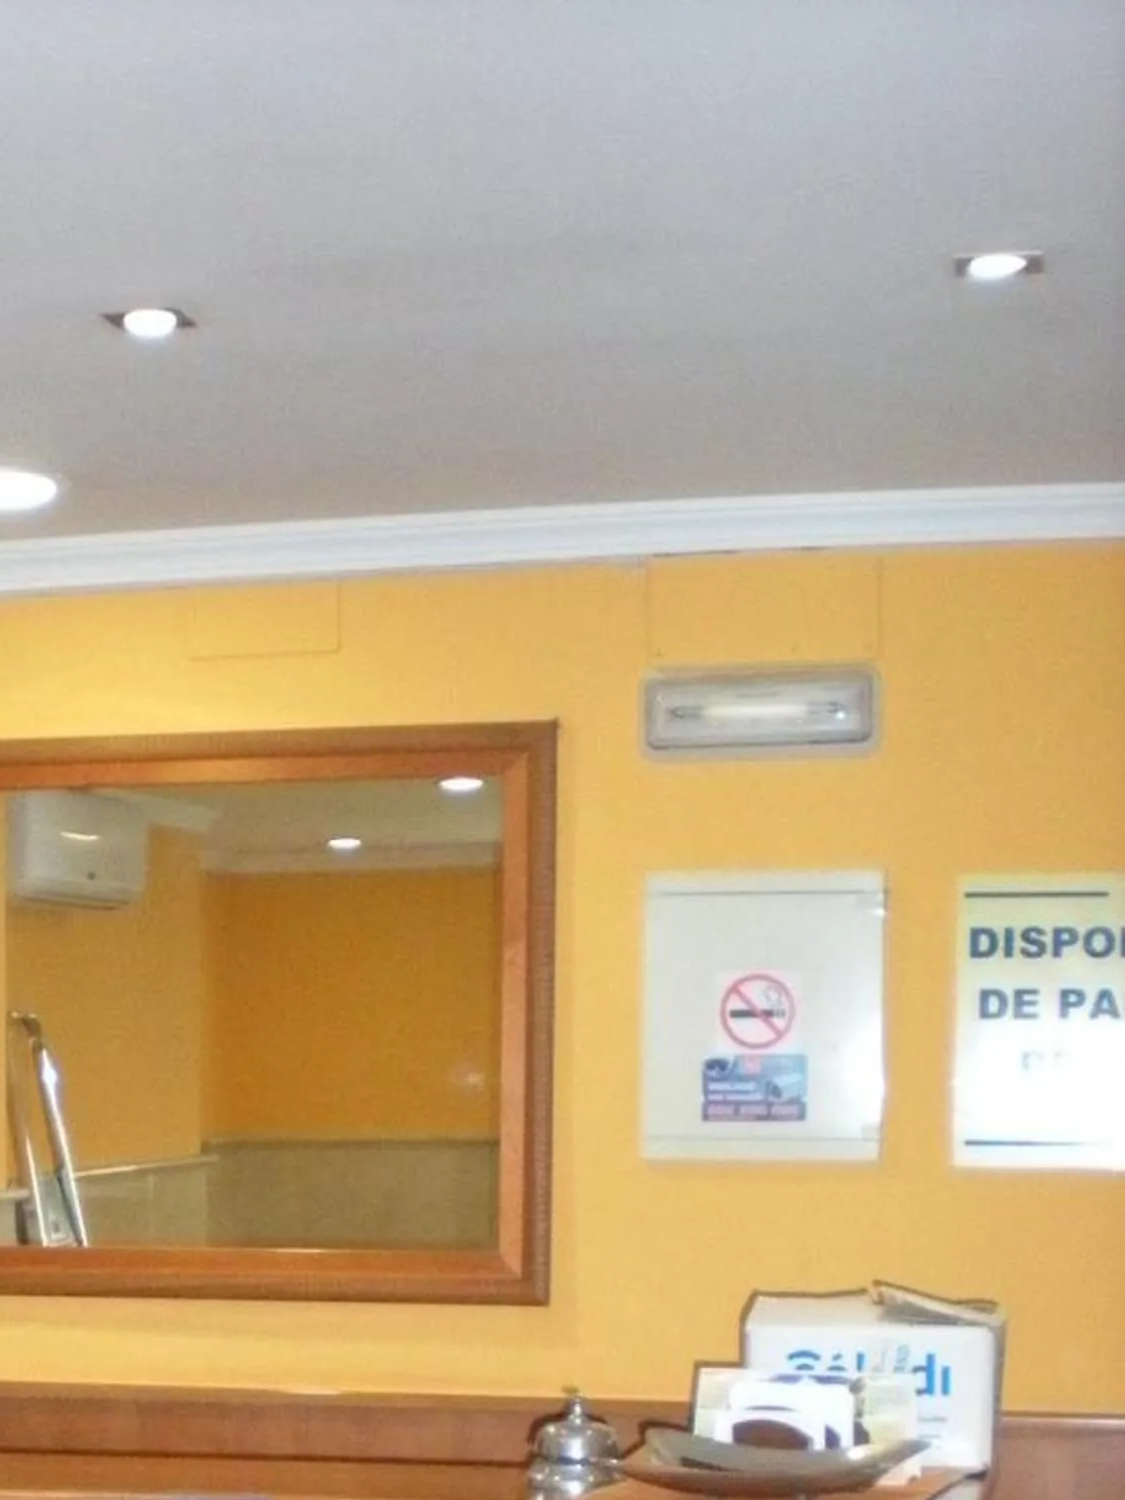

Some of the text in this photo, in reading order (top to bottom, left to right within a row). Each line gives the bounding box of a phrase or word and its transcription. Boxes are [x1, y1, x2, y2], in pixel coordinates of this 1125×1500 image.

[969, 926, 1125, 959] DISPO
[979, 988, 1125, 1020] DE PA
